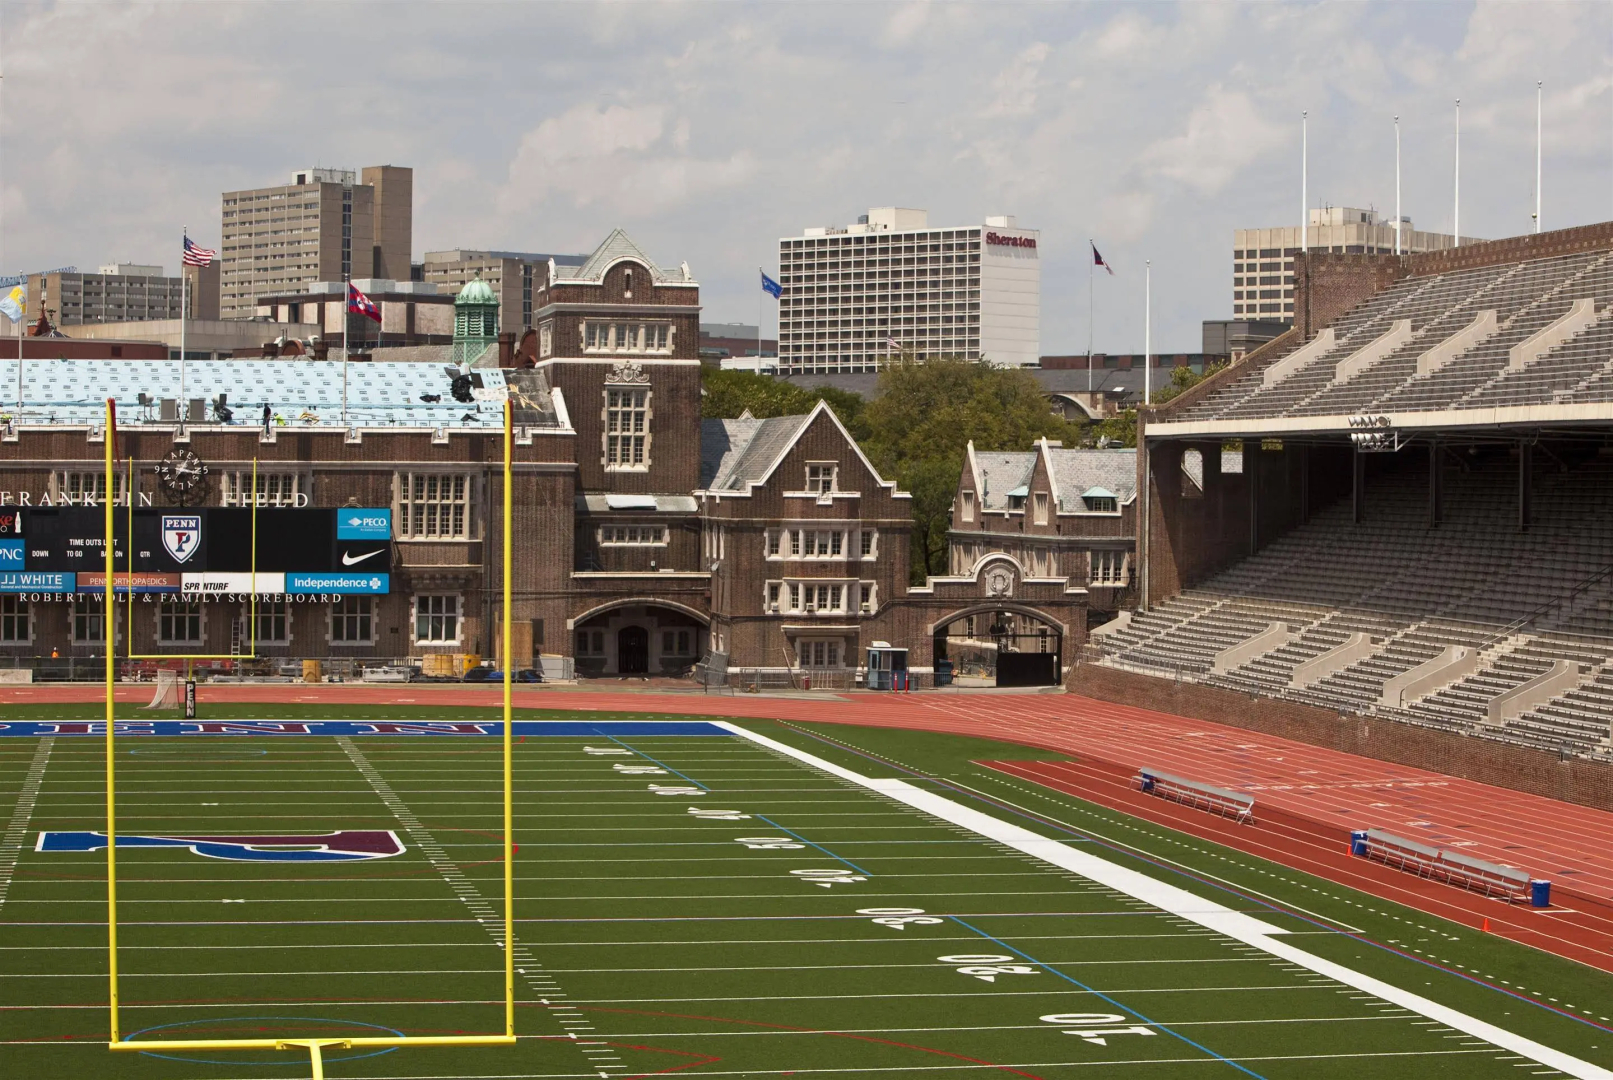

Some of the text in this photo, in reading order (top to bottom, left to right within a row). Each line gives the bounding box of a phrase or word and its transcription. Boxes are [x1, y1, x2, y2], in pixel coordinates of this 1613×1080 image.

[986, 231, 1037, 248] Sheraton
[222, 492, 309, 508] FIELD
[165, 519, 197, 528] PENN
[363, 518, 386, 527] PECO
[0, 548, 23, 560] NC
[1, 575, 63, 585] JJ WHITE
[295, 578, 368, 590] Independence
[20, 593, 85, 602] ROBERT
[142, 593, 152, 602] &
[160, 593, 222, 602] FAMILY
[228, 593, 341, 603] SCOREBOARD
[186, 683, 195, 717] PENN
[0, 722, 496, 735] ENN
[855, 907, 944, 925] 30
[936, 954, 1041, 976] 20
[1038, 1013, 1158, 1038] 10
